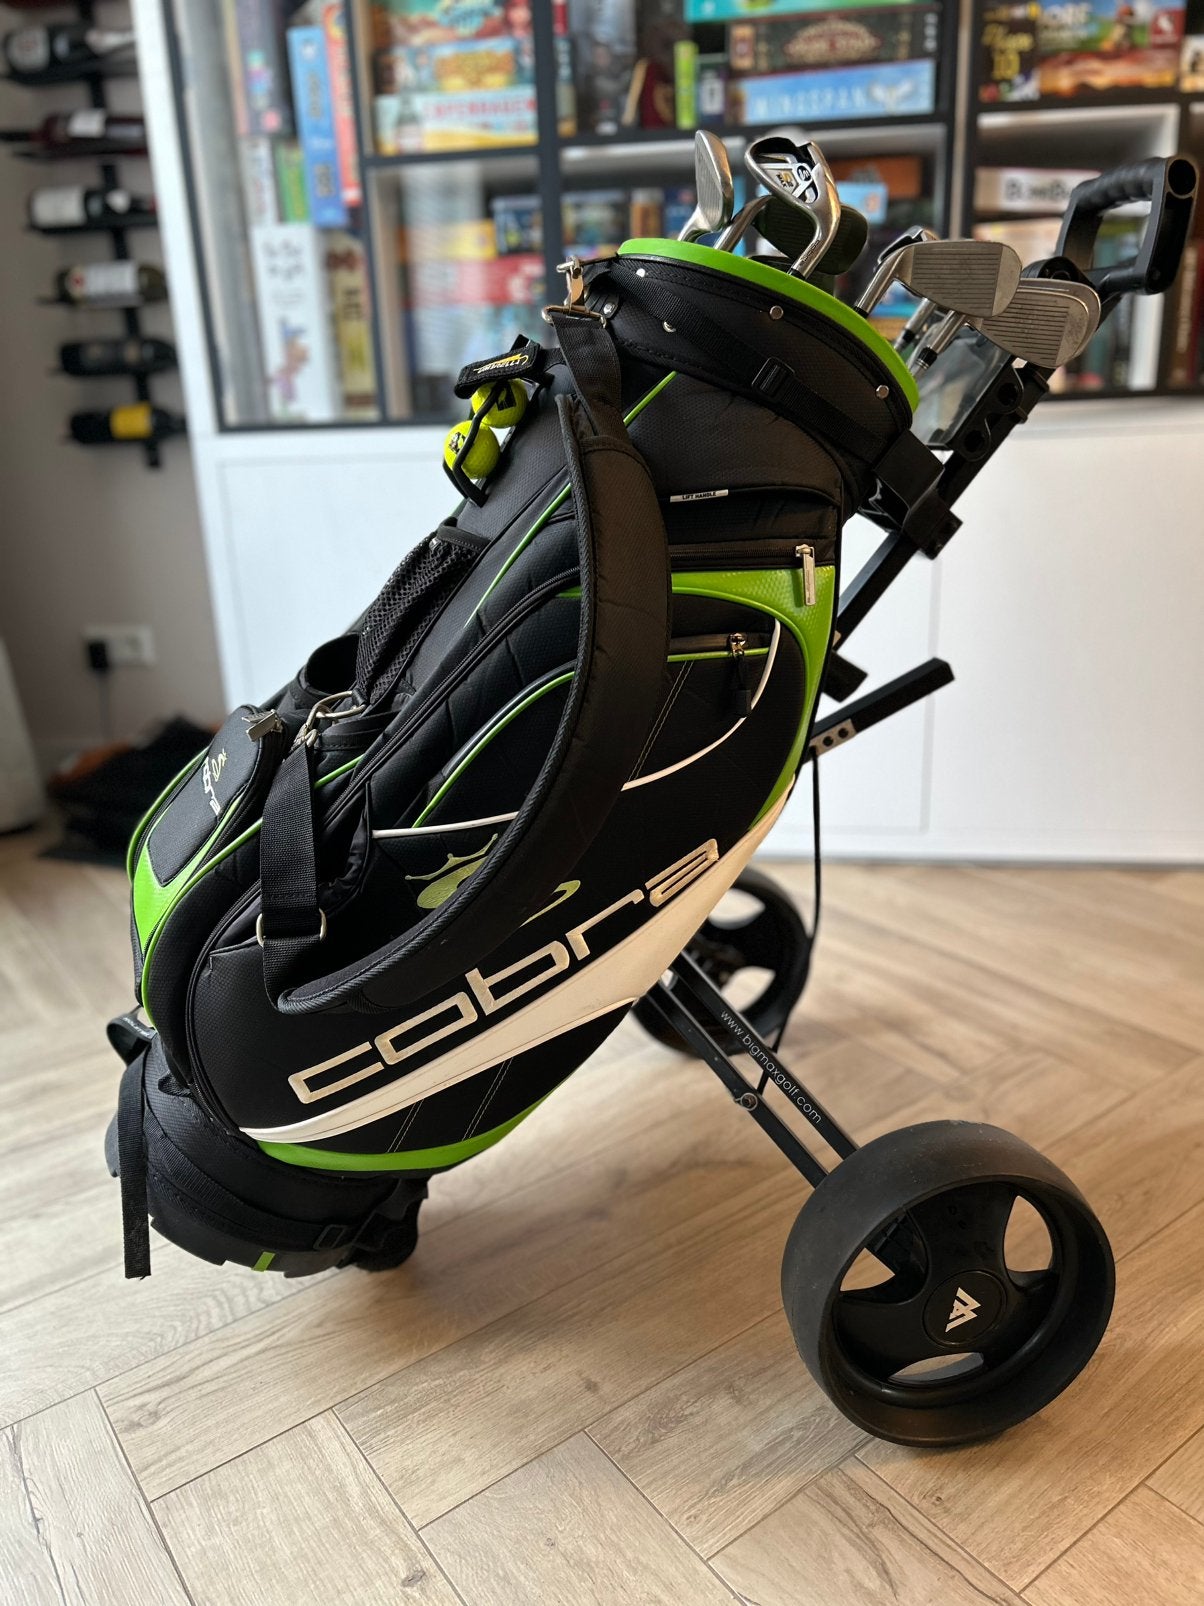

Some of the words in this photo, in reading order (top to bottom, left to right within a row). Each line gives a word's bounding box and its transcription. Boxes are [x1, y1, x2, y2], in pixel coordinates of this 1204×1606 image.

[682, 493, 694, 501] LIFT
[695, 491, 717, 499] HANDLE
[287, 838, 720, 1104] cobra
[720, 1009, 823, 1124] www.bigmaxgolf.com
